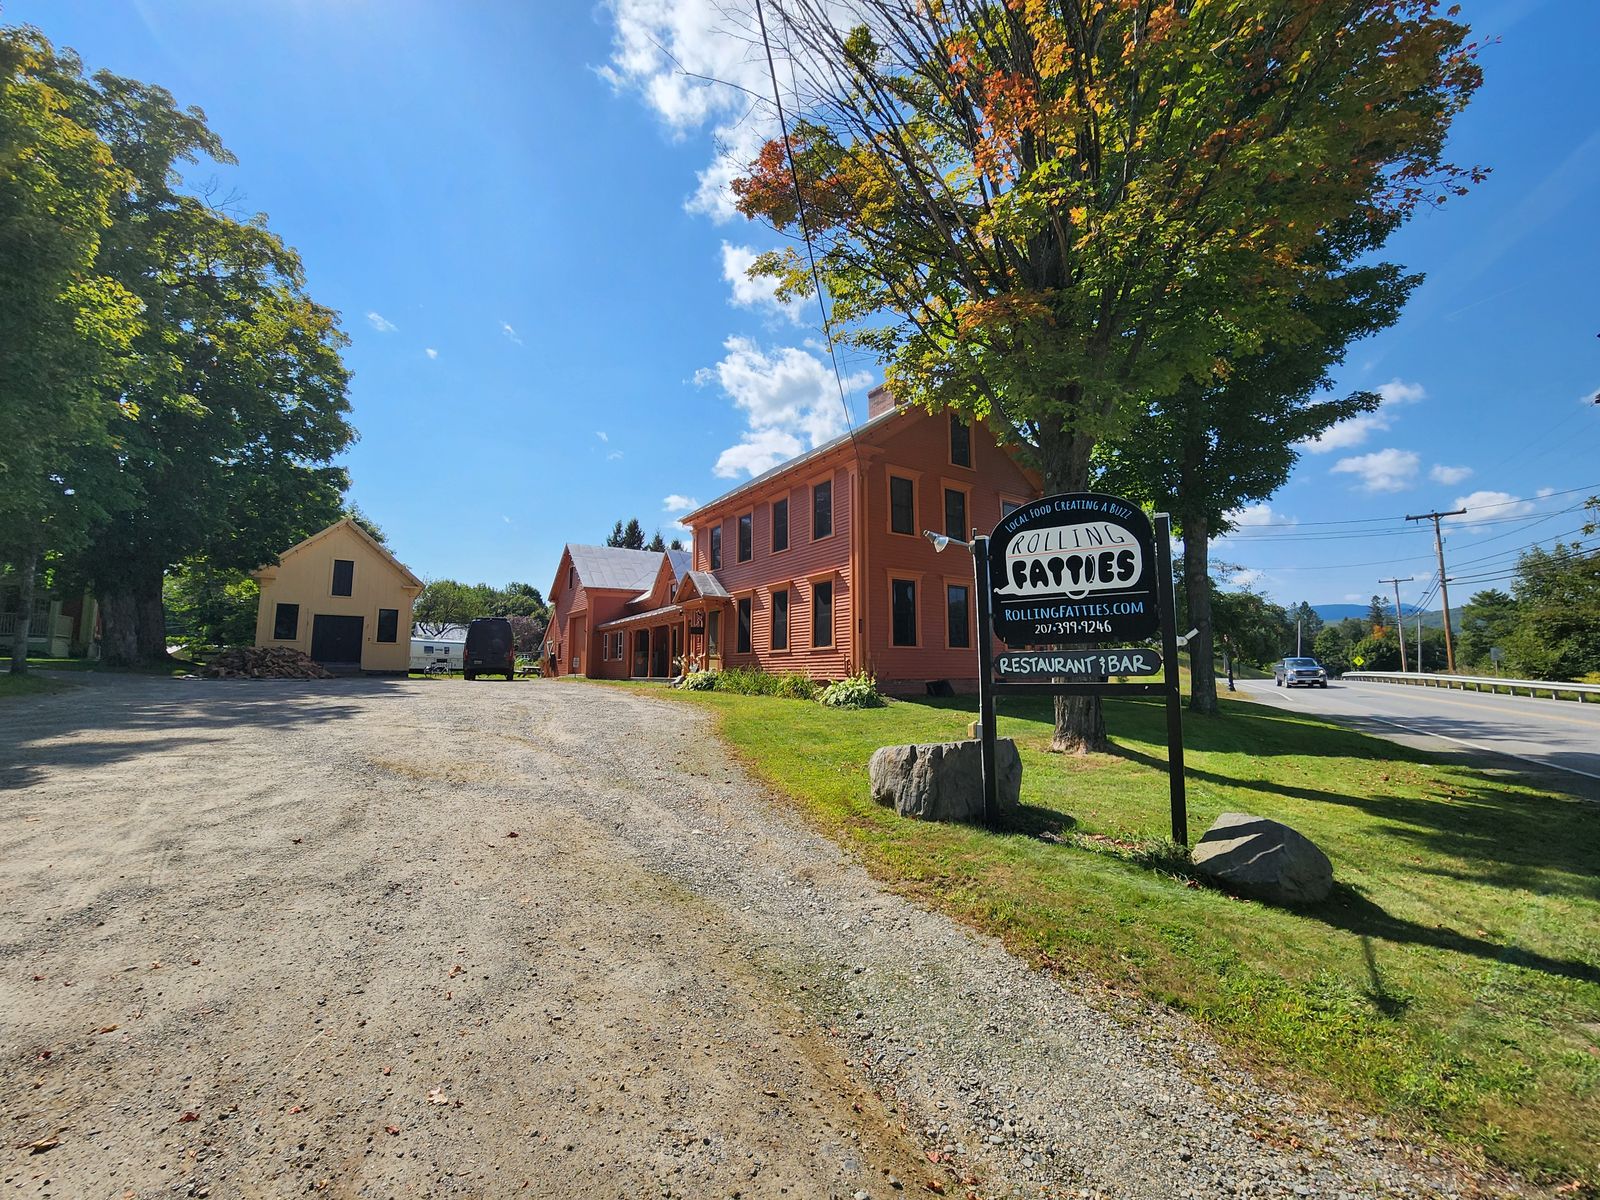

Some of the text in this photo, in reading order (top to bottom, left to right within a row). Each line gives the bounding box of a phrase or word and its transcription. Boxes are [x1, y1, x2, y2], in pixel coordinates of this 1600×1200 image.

[1005, 500, 1133, 533] LOCAL FOOD CREATING A BUZZ
[1012, 524, 1125, 555] ROLLING
[1011, 549, 1135, 590] FATTIES
[1005, 601, 1144, 621] ROLLINGFATTIES.COM
[1000, 655, 1097, 674] RESTAURANT
[1107, 654, 1152, 673] BAR
